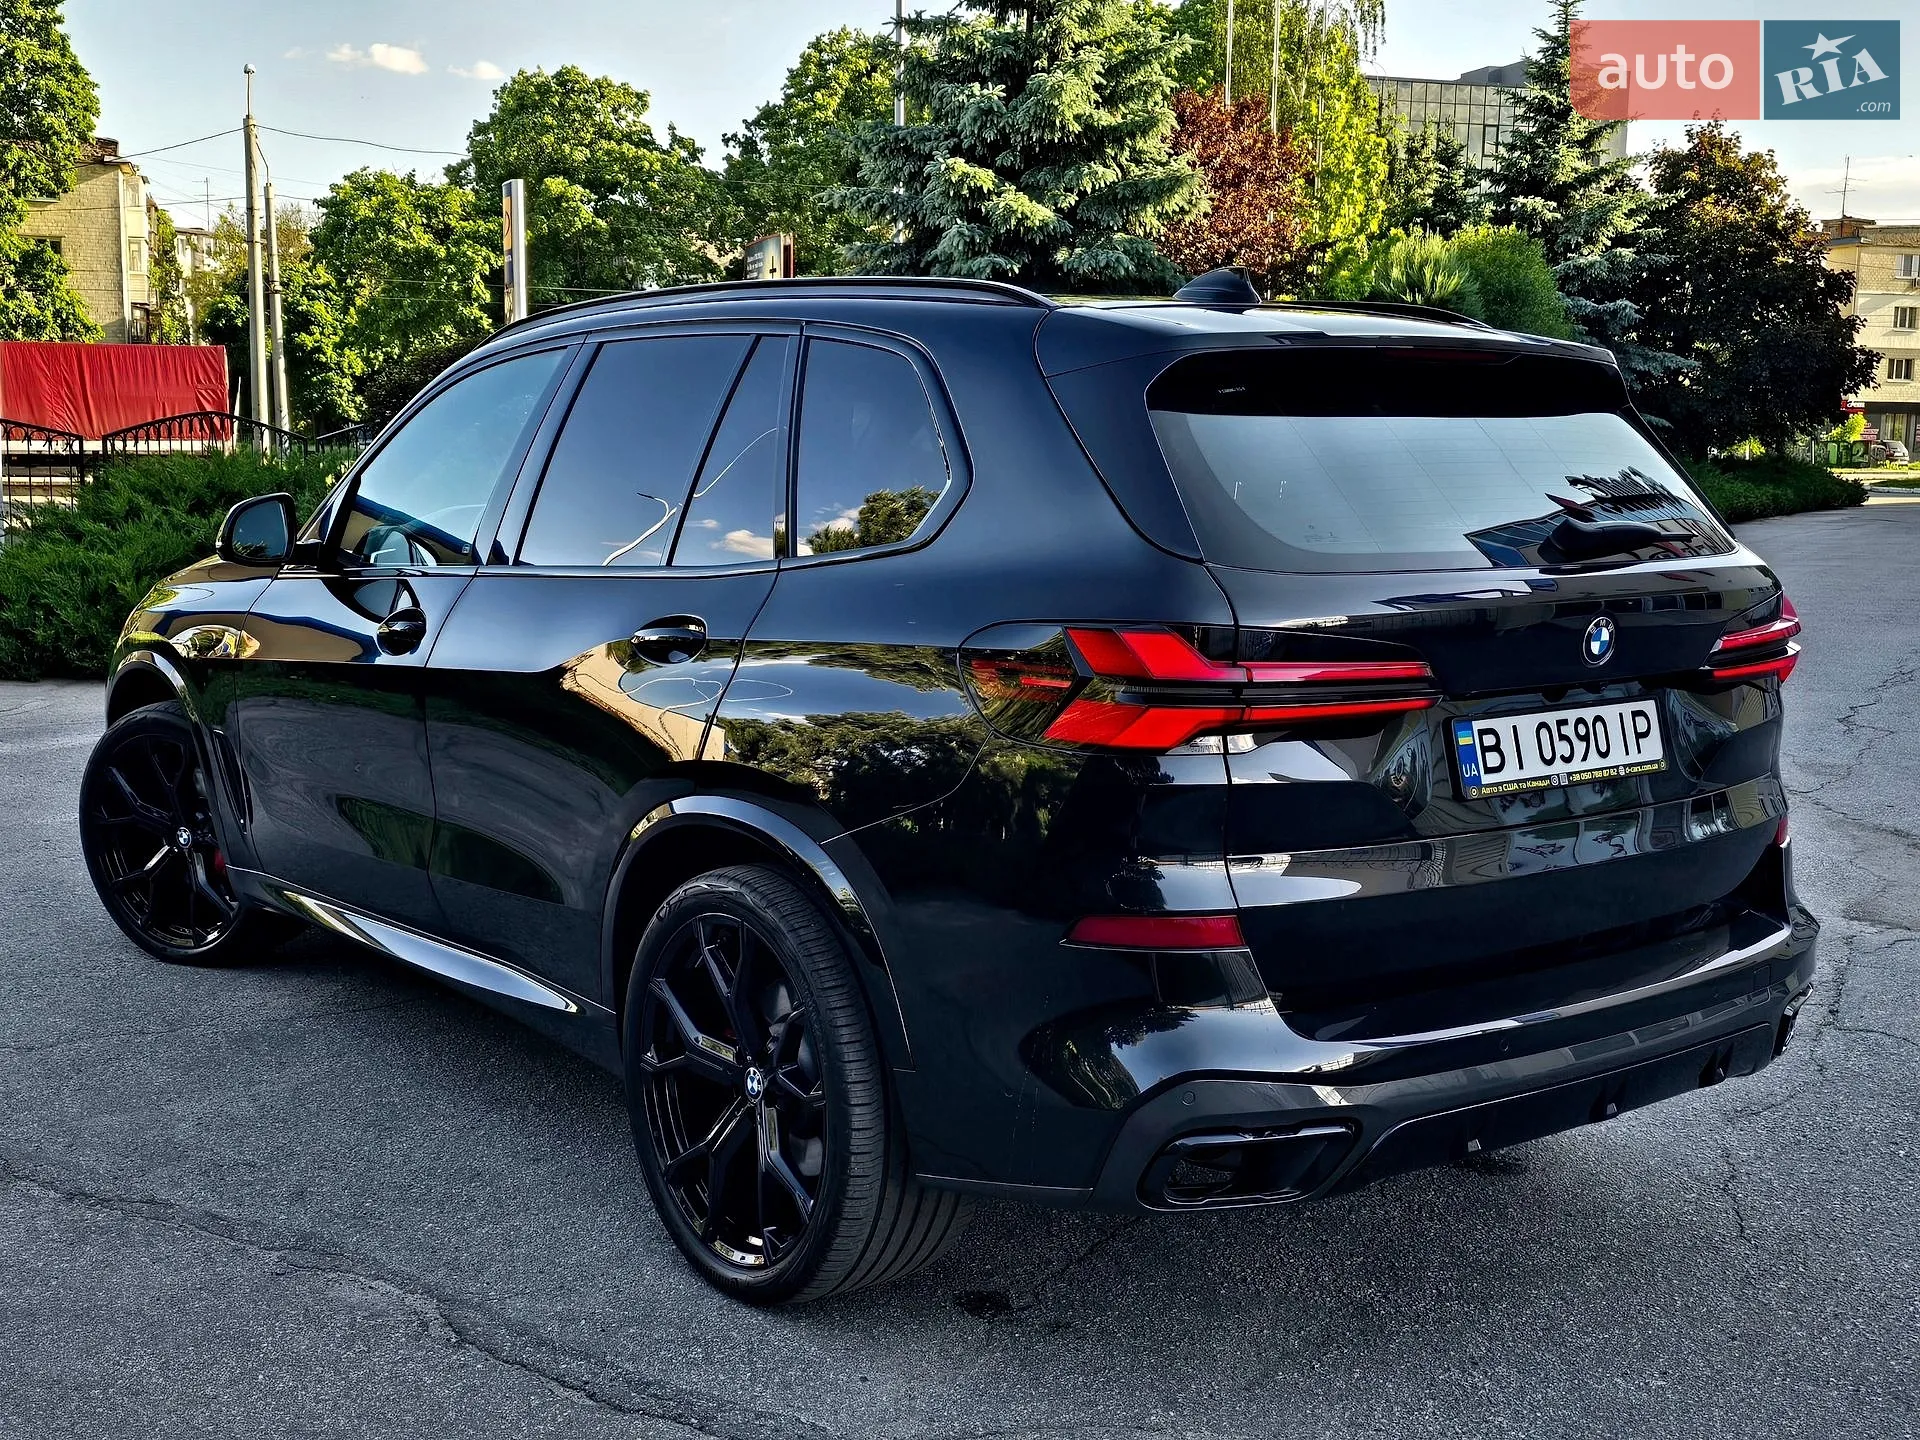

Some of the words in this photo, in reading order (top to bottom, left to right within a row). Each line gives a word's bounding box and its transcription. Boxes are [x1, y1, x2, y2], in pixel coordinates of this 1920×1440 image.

[1590, 619, 1614, 634] BMW
[1477, 724, 1524, 775] BI
[1535, 714, 1611, 767] 0590
[1618, 709, 1652, 756] IP
[1462, 762, 1479, 777] UA
[1481, 786, 1498, 794] Авто
[1502, 782, 1519, 791] США
[1526, 779, 1550, 787] Канади
